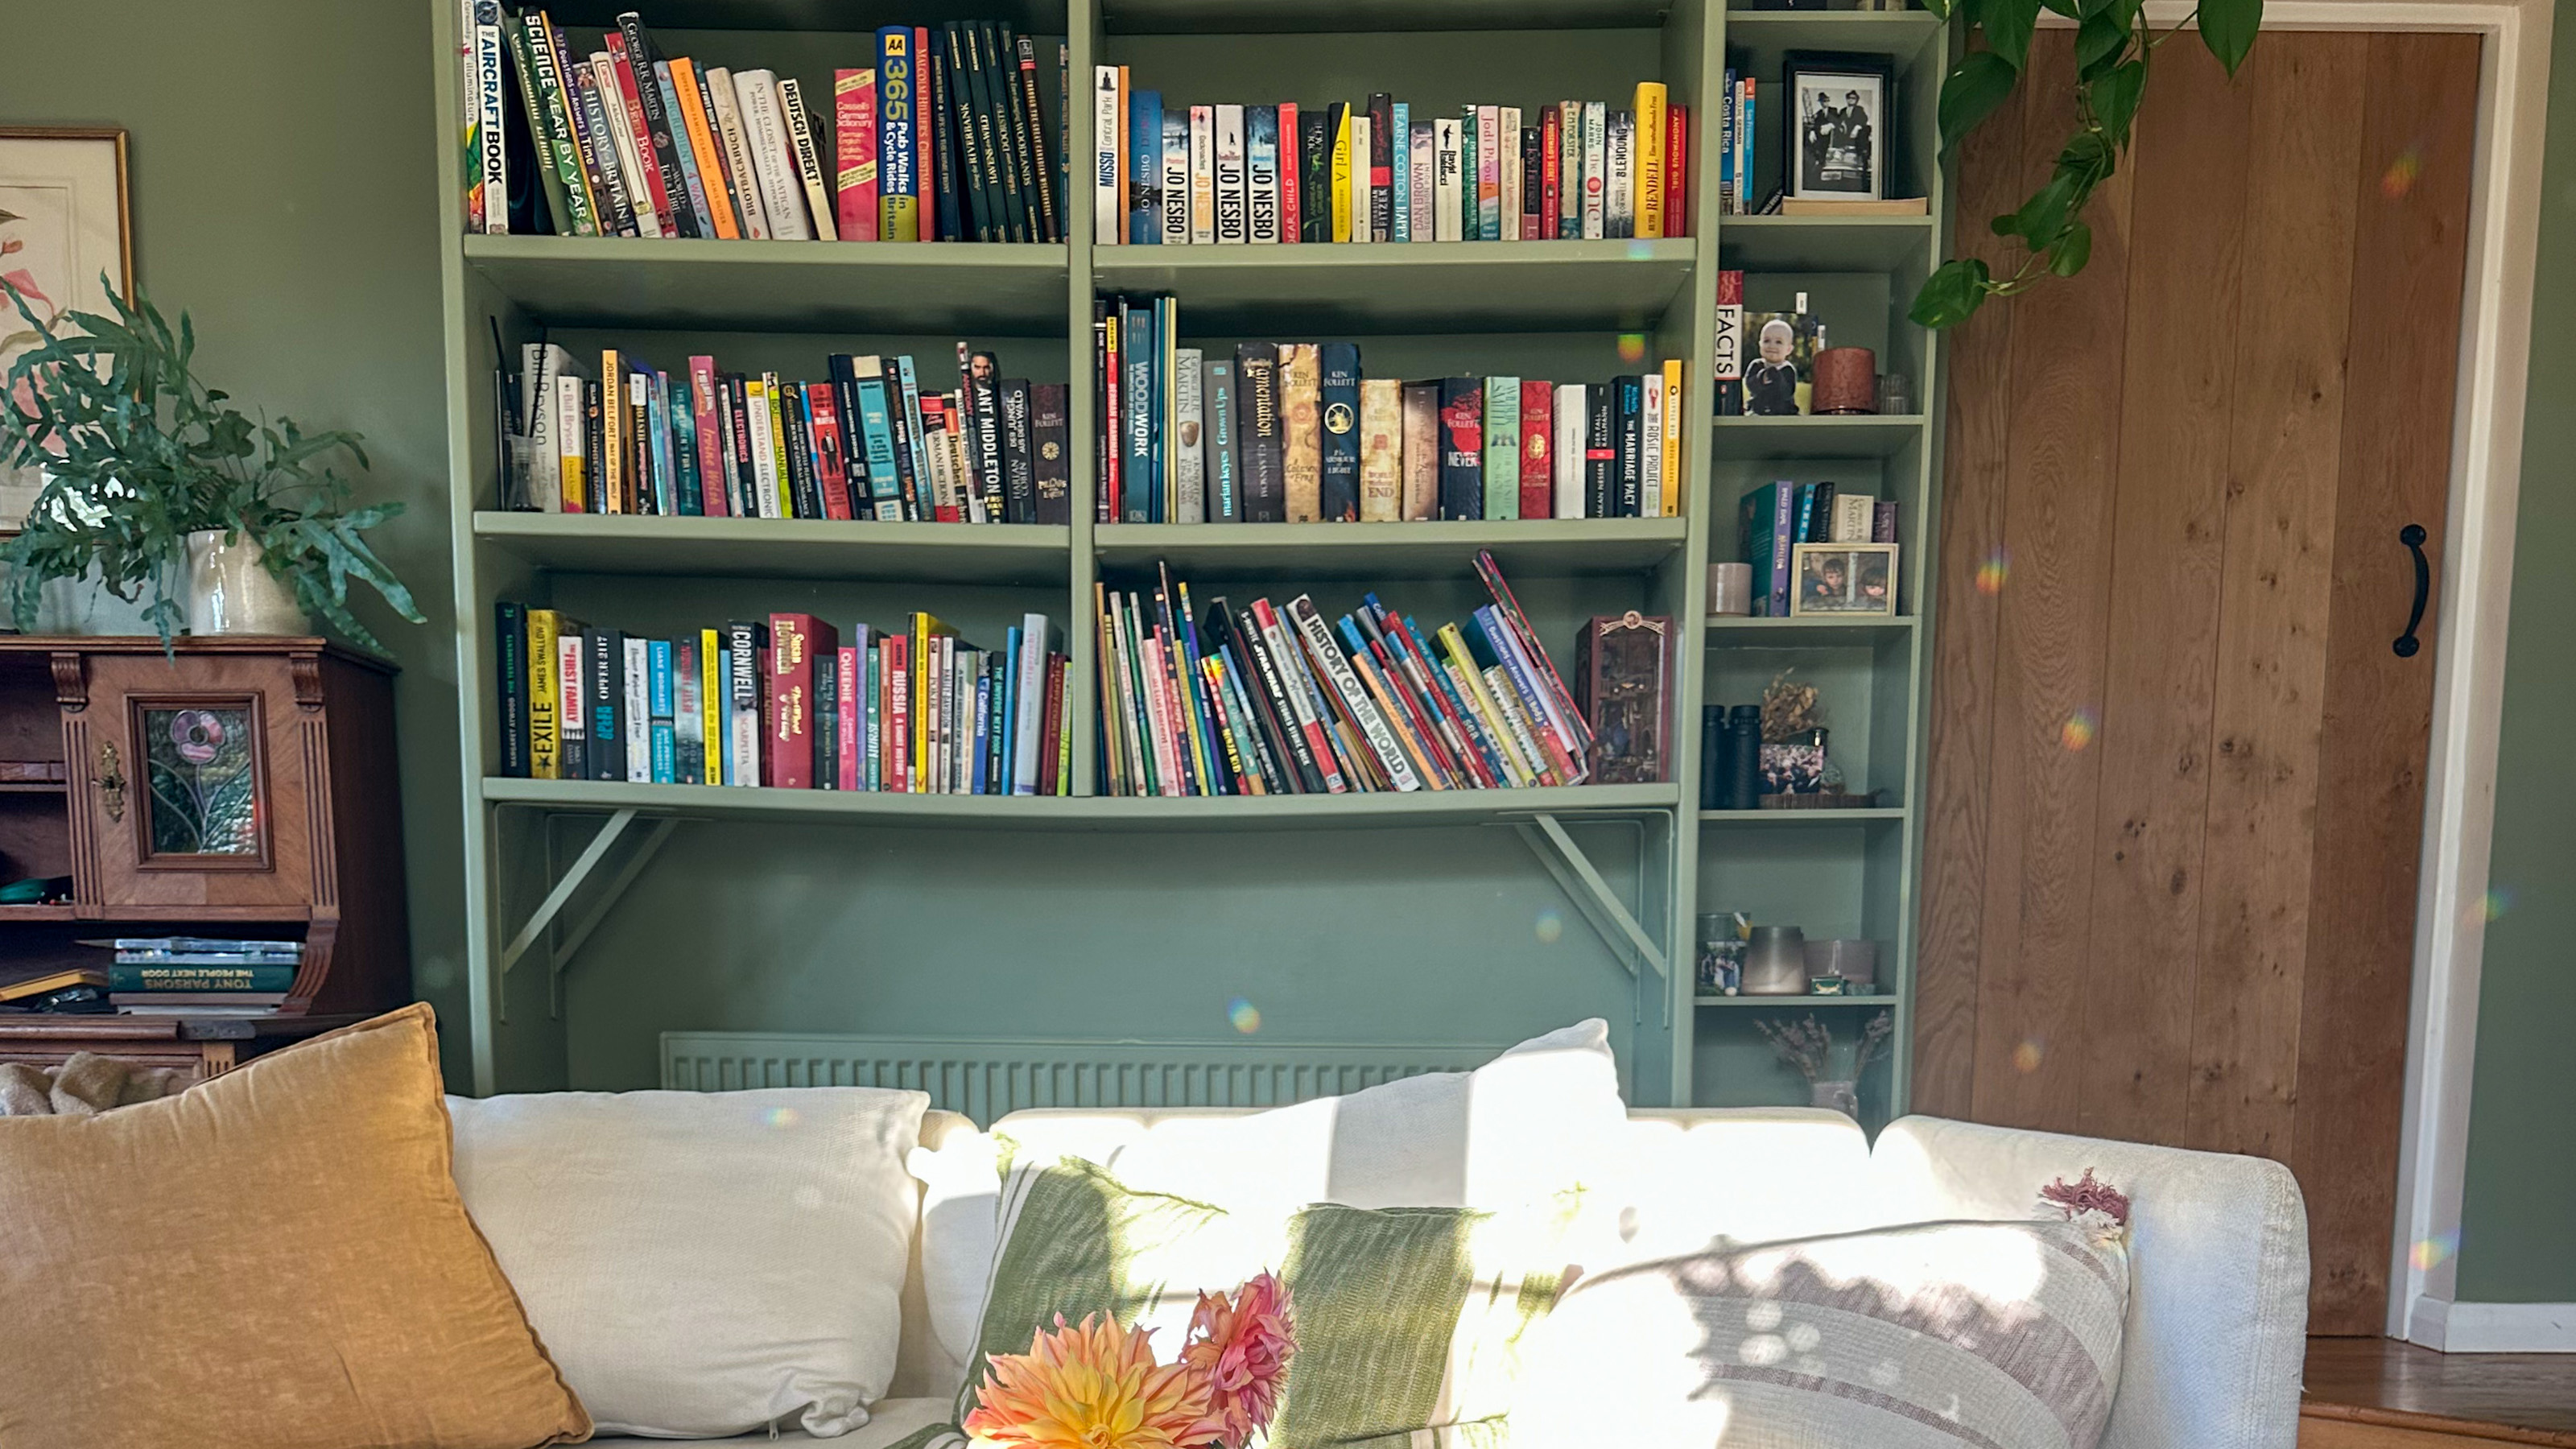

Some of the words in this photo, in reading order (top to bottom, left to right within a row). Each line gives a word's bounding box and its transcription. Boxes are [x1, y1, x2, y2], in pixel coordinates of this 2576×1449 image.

[888, 39, 902, 51] AA
[482, 39, 499, 129] AIRCRAFT
[627, 23, 644, 63] GEORGE
[642, 81, 661, 121] MARTIN
[918, 48, 927, 93] MALCOLM
[885, 59, 908, 120] 365
[1101, 97, 1113, 115] Park
[525, 15, 557, 89] SCIENCE
[547, 92, 568, 138] YEAR
[559, 144, 575, 166] BY
[568, 171, 586, 218] YEAR
[691, 113, 703, 137] FAMILY
[784, 82, 807, 136] DEUTSCH
[886, 122, 896, 130] &
[996, 102, 1010, 152] DOORSTEP
[1723, 96, 1732, 127] Costa
[884, 132, 896, 161] Cycle
[897, 122, 909, 148] Pub
[960, 102, 977, 164] RIVERBANK
[1101, 119, 1113, 146] Central
[1395, 108, 1406, 151] FEARNE
[1481, 115, 1494, 142] Jodi
[1722, 130, 1732, 154] Rica
[485, 131, 502, 184] BOOK
[584, 90, 611, 155] HISTORY
[604, 161, 629, 220] BRITAIN
[637, 136, 654, 172] BOOK
[666, 97, 693, 166] INGREDIENT
[690, 184, 706, 214] WAYS
[762, 115, 778, 155] CLOSET
[775, 178, 793, 219] VATICAN
[919, 141, 929, 191] CHRISTMAS
[1015, 122, 1032, 185] WOODLANDS
[1099, 151, 1115, 188] MUSSO
[1335, 140, 1348, 167] Girl
[1439, 150, 1449, 186] Baldacci
[1448, 151, 1456, 174] David
[1484, 147, 1494, 190] Picoult
[1616, 128, 1627, 177] BLENDUNG
[728, 127, 756, 217] BROTBACKBUCH
[886, 163, 897, 193] Rides
[898, 151, 909, 193] Walks
[1166, 167, 1185, 185] JO
[1195, 172, 1210, 188] JO
[1220, 163, 1241, 184] JO
[1253, 164, 1273, 184] JO
[1335, 172, 1346, 182] A
[1395, 153, 1406, 203] COTTON
[1414, 163, 1424, 204] BROWN
[1646, 159, 1659, 212] RENDELL
[1671, 171, 1679, 190] GIRL
[899, 197, 908, 208] in
[1141, 199, 1150, 216] JO
[1166, 188, 1185, 233] NESBO
[1220, 189, 1241, 238] NESBO
[1286, 178, 1294, 212] CHILD
[1379, 189, 1388, 226] FITZEK
[888, 197, 896, 240] Britain
[1253, 189, 1274, 239] NESBO
[1395, 206, 1407, 239] HAPPY
[1414, 206, 1424, 231] DAN
[1716, 308, 1734, 374] FACTS
[531, 349, 547, 377] Bill
[606, 361, 615, 398] JORDAN
[961, 374, 974, 416] ANATOMY
[1178, 356, 1191, 414] MARTIN
[1216, 387, 1228, 408] Ups
[1323, 378, 1356, 386] FOLLETT
[534, 382, 549, 445] Bryson
[564, 394, 574, 413] Bill
[606, 399, 616, 439] BELFORT
[977, 388, 993, 414] ANT
[1006, 396, 1018, 431] JUNGE
[1013, 390, 1025, 419] WALD
[1133, 361, 1149, 457] WOODWORK
[564, 414, 576, 453] Bryson
[734, 409, 749, 463] ELECTRONICS
[753, 400, 768, 462] UNDERSTAND
[1009, 432, 1017, 448] DER
[1216, 410, 1228, 445] Grown
[1447, 419, 1480, 427] FOLLETT
[1647, 426, 1659, 452] ROSIE
[703, 427, 716, 466] Irvine
[778, 446, 786, 482] MANUAL
[948, 436, 961, 486] Deutsches
[980, 418, 1001, 493] MIDDLETON
[1221, 451, 1231, 479] keyes
[1448, 452, 1481, 467] NEVER
[1624, 433, 1637, 481] MARRIAGE
[708, 469, 720, 506] Welsh
[1011, 459, 1021, 499] HARLAN
[1259, 459, 1268, 497] SANSOM
[1646, 455, 1658, 487] PROJECT
[936, 465, 949, 517] DICTIONARY
[1223, 480, 1232, 516] marian
[1368, 487, 1394, 498] END
[1624, 483, 1635, 506] PACT
[536, 626, 546, 666] SWALLOW
[597, 636, 608, 660] 2117
[791, 633, 804, 663] Susan
[1488, 625, 1511, 660] Questions
[1509, 665, 1530, 696] Answers
[536, 667, 547, 694] JAMES
[565, 654, 577, 685] FIRST
[598, 663, 609, 700] OPFER
[732, 631, 753, 700] CORNWELL
[840, 653, 852, 702] QUEENIE
[1253, 642, 1272, 672] STAR
[1265, 670, 1283, 700] WARS
[566, 686, 578, 723] FAMILY
[657, 672, 665, 713] MORIARTY
[892, 671, 906, 714] RUSSIA
[1307, 618, 1348, 678] HISTORY
[1340, 675, 1361, 700] OF
[1353, 697, 1377, 726] THE
[1368, 723, 1406, 776] WORLD
[533, 702, 553, 753] EXILE
[976, 690, 988, 737] California
[1156, 710, 1168, 745] parent
[740, 717, 749, 765] SCARPETTA
[1222, 729, 1236, 756] NINJA
[1229, 755, 1241, 774] KID
[141, 969, 170, 977] DOOR
[144, 979, 210, 989] PARSONS
[171, 969, 196, 977] NEXT
[213, 979, 253, 989] TONY
[234, 969, 254, 977] THE
